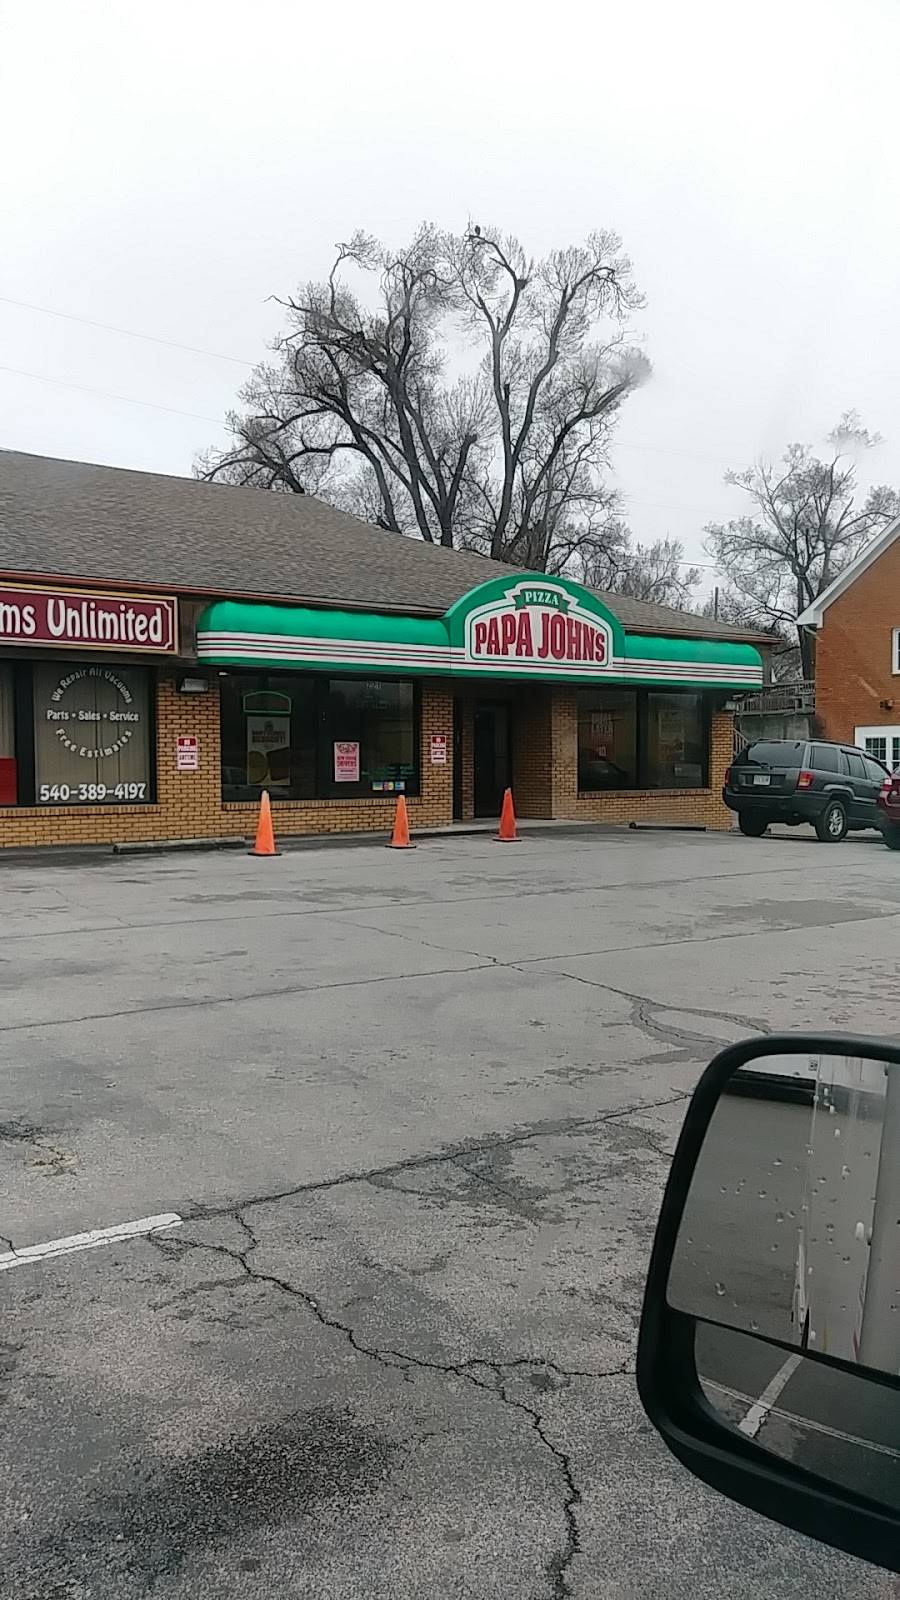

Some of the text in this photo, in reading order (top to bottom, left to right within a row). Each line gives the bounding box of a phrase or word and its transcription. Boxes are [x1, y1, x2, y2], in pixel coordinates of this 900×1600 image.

[524, 591, 560, 606] PIZZA
[47, 599, 163, 643] Unlimited
[474, 612, 606, 662] PAPA JOHN'S
[51, 667, 133, 704] We Repair All Vacuums
[47, 709, 139, 721] Parts Sales Service
[56, 728, 132, 758] Free Estimates
[40, 783, 147, 801] 540-389-4197
